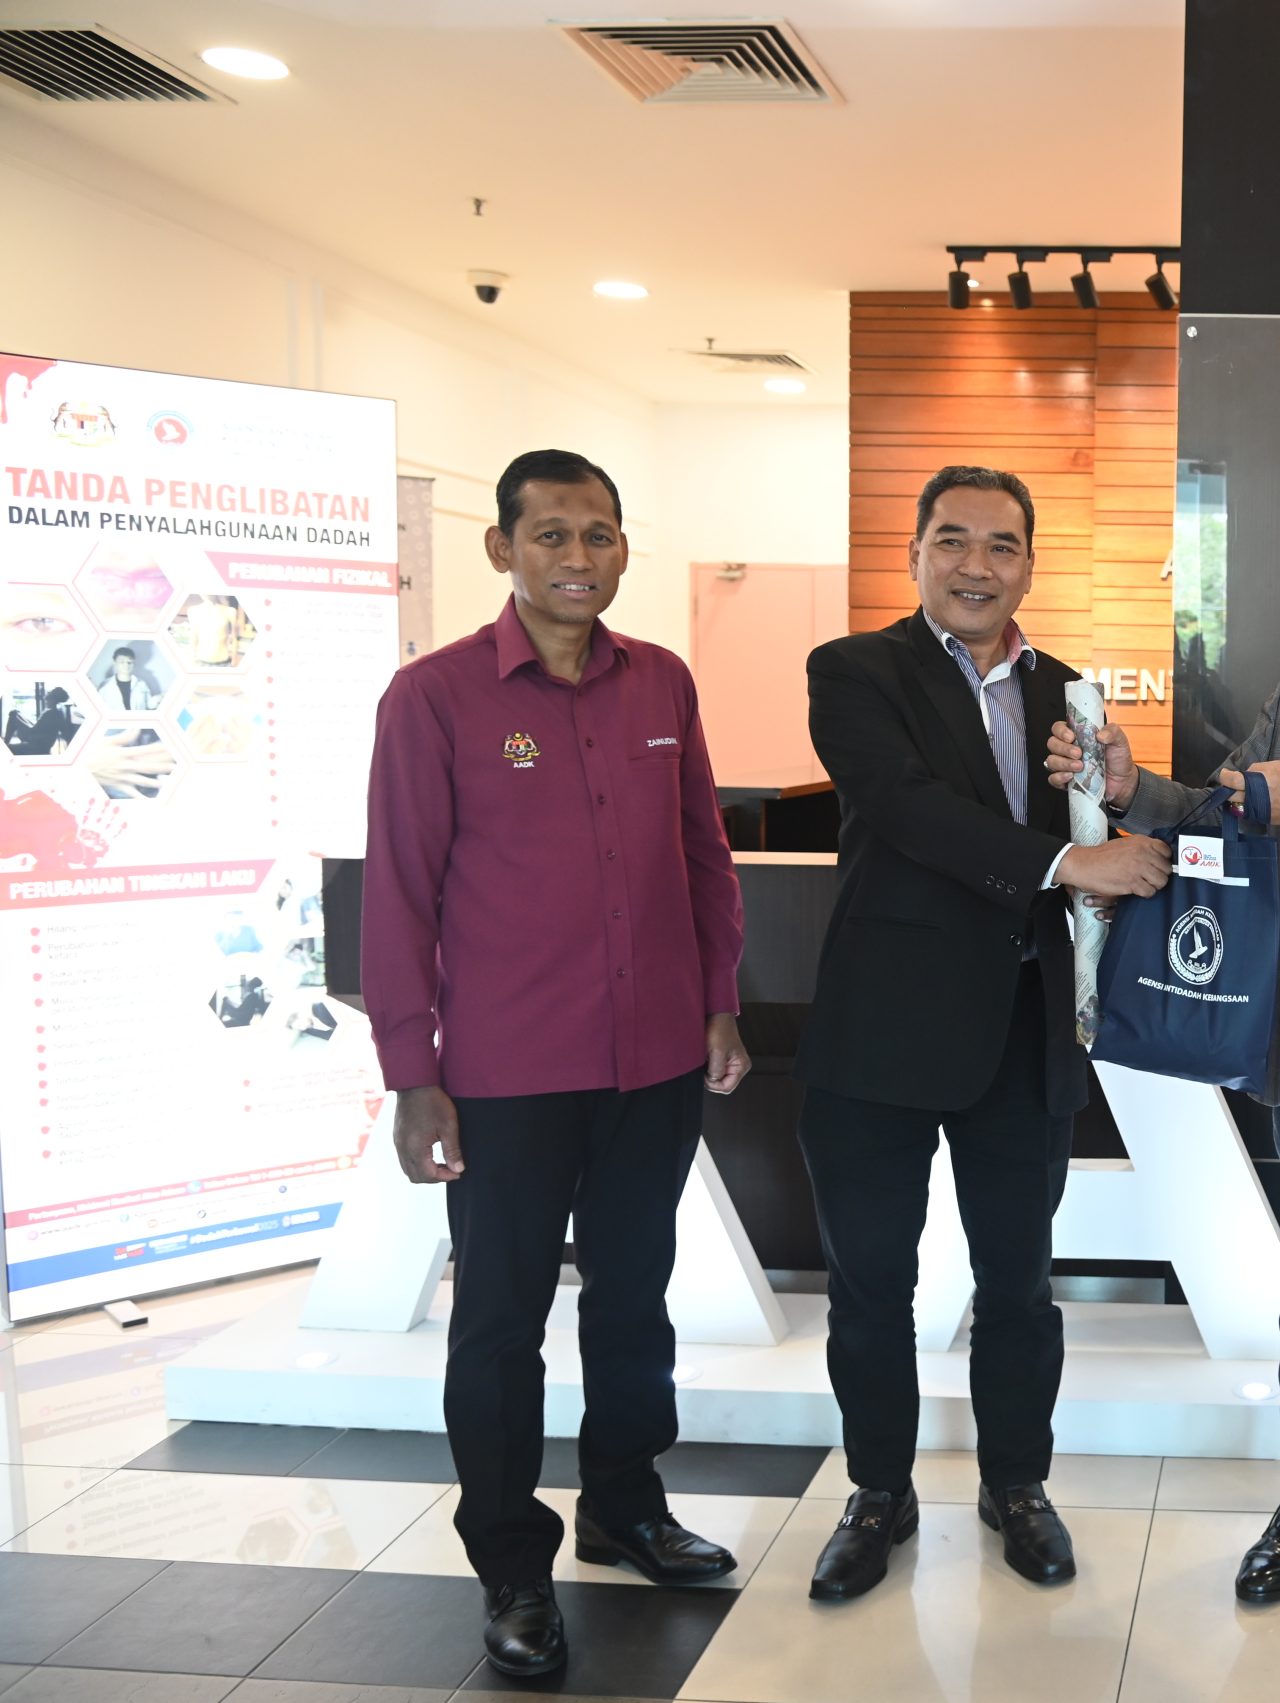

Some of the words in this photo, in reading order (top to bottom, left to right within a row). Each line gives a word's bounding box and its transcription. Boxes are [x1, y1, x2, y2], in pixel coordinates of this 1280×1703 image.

[5, 466, 131, 505] TANDA
[145, 478, 371, 523] PENGLIBATAN
[7, 505, 91, 529] DALAM
[100, 511, 299, 542] PENYALAHGUNAAN
[306, 526, 371, 547] DADAH
[227, 562, 330, 584] PERUBAHAN
[331, 567, 393, 588] FIZIKAL
[513, 760, 535, 769] AADK
[9, 876, 125, 900] PERUBAHAN
[209, 868, 256, 888] LAKU
[1137, 976, 1164, 991] AGENSI
